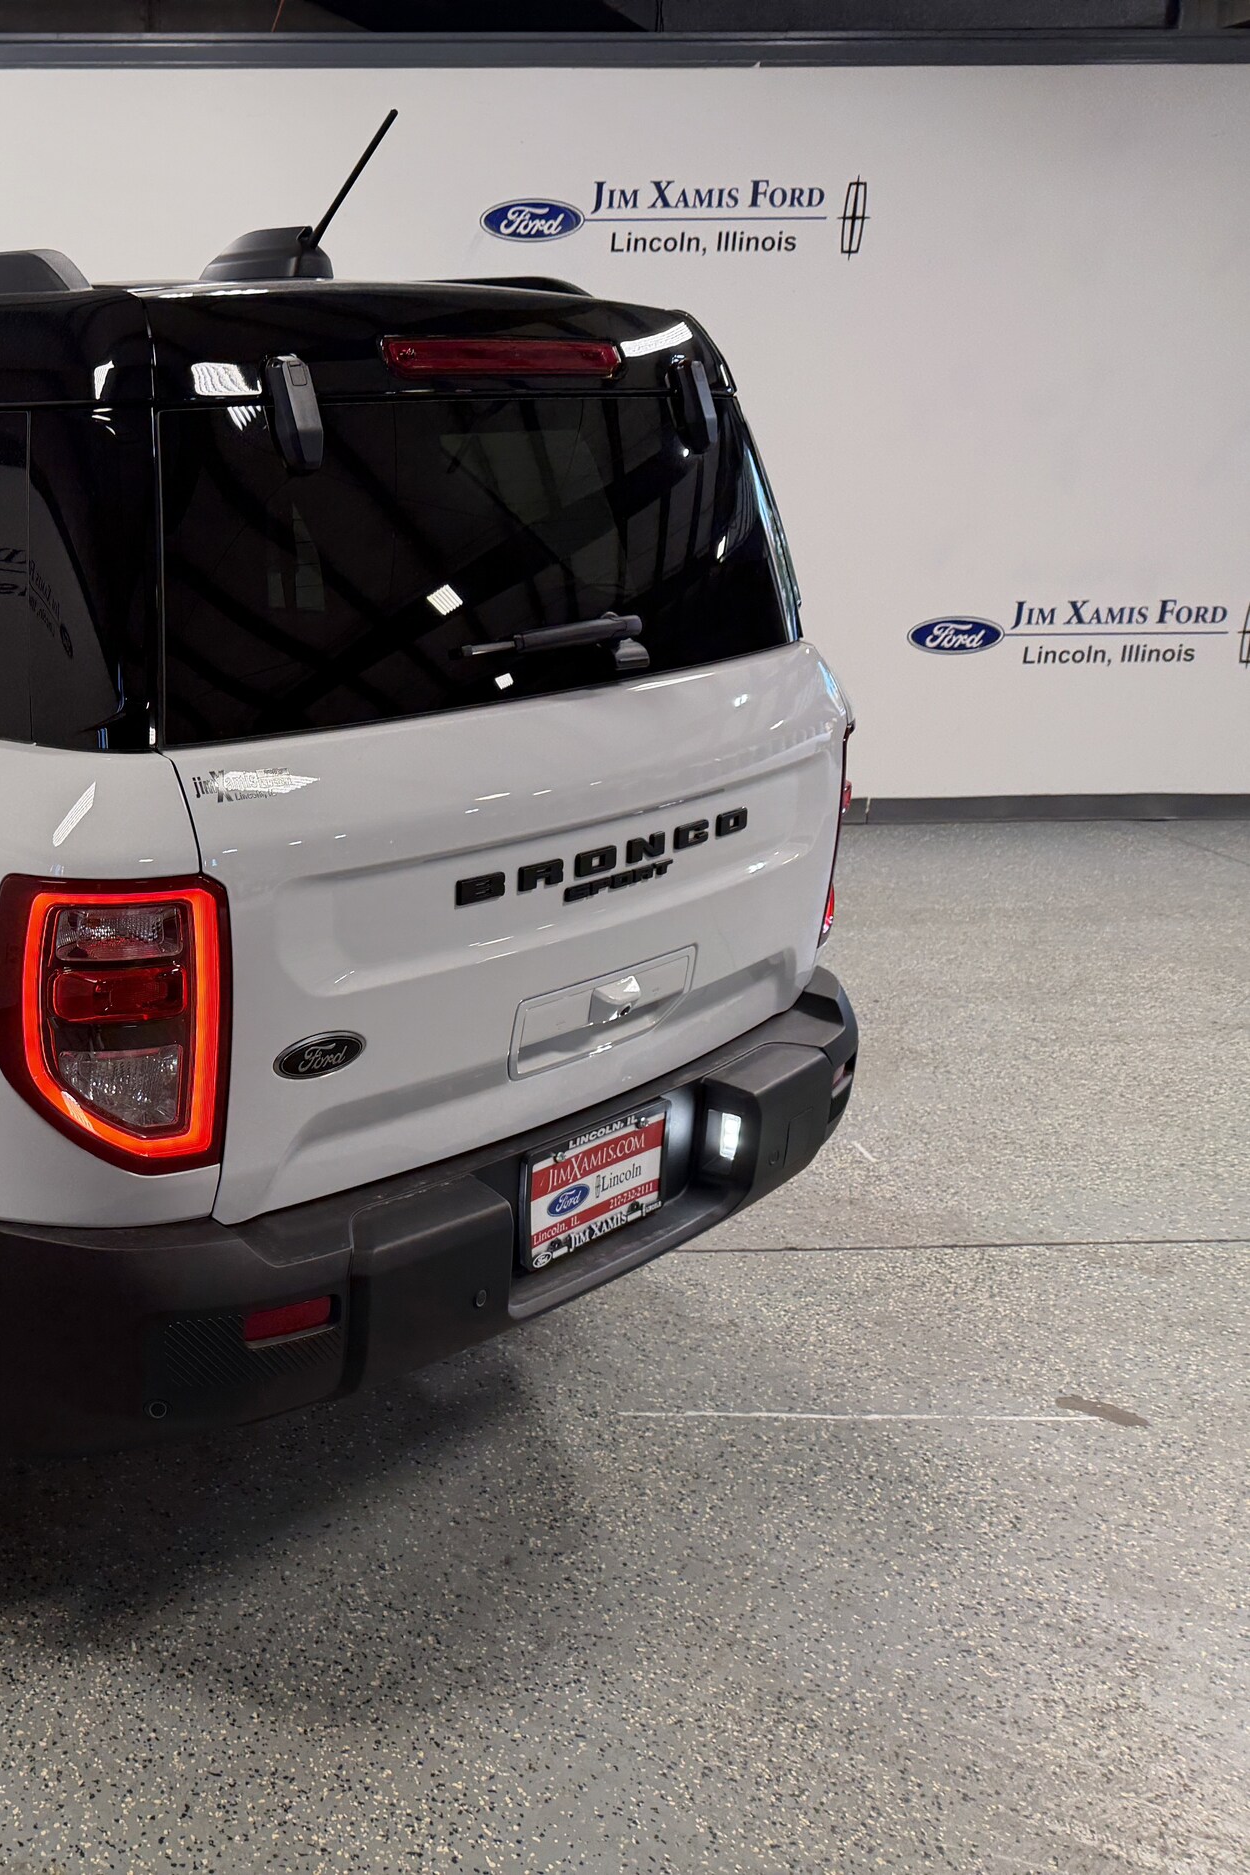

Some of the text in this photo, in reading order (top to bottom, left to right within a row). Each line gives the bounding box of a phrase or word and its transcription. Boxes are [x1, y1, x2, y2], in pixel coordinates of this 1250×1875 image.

[590, 179, 825, 214] JIM XAMIS FORD
[499, 206, 563, 236] Ford
[610, 231, 797, 256] Lincoln, Illinois
[1010, 599, 1228, 630] JIM XAMIS FORD
[925, 622, 984, 649] Ford
[1022, 645, 1196, 667] Lincoln, Illinois
[455, 806, 748, 906] BRONCO
[563, 858, 674, 904] SPORT
[298, 1042, 348, 1073] Ford
[568, 1115, 638, 1149] LINCOLN, IL
[601, 1164, 642, 1192] Lincoln
[569, 1212, 627, 1252] JIM XAMIS
[570, 1216, 580, 1227] IL
